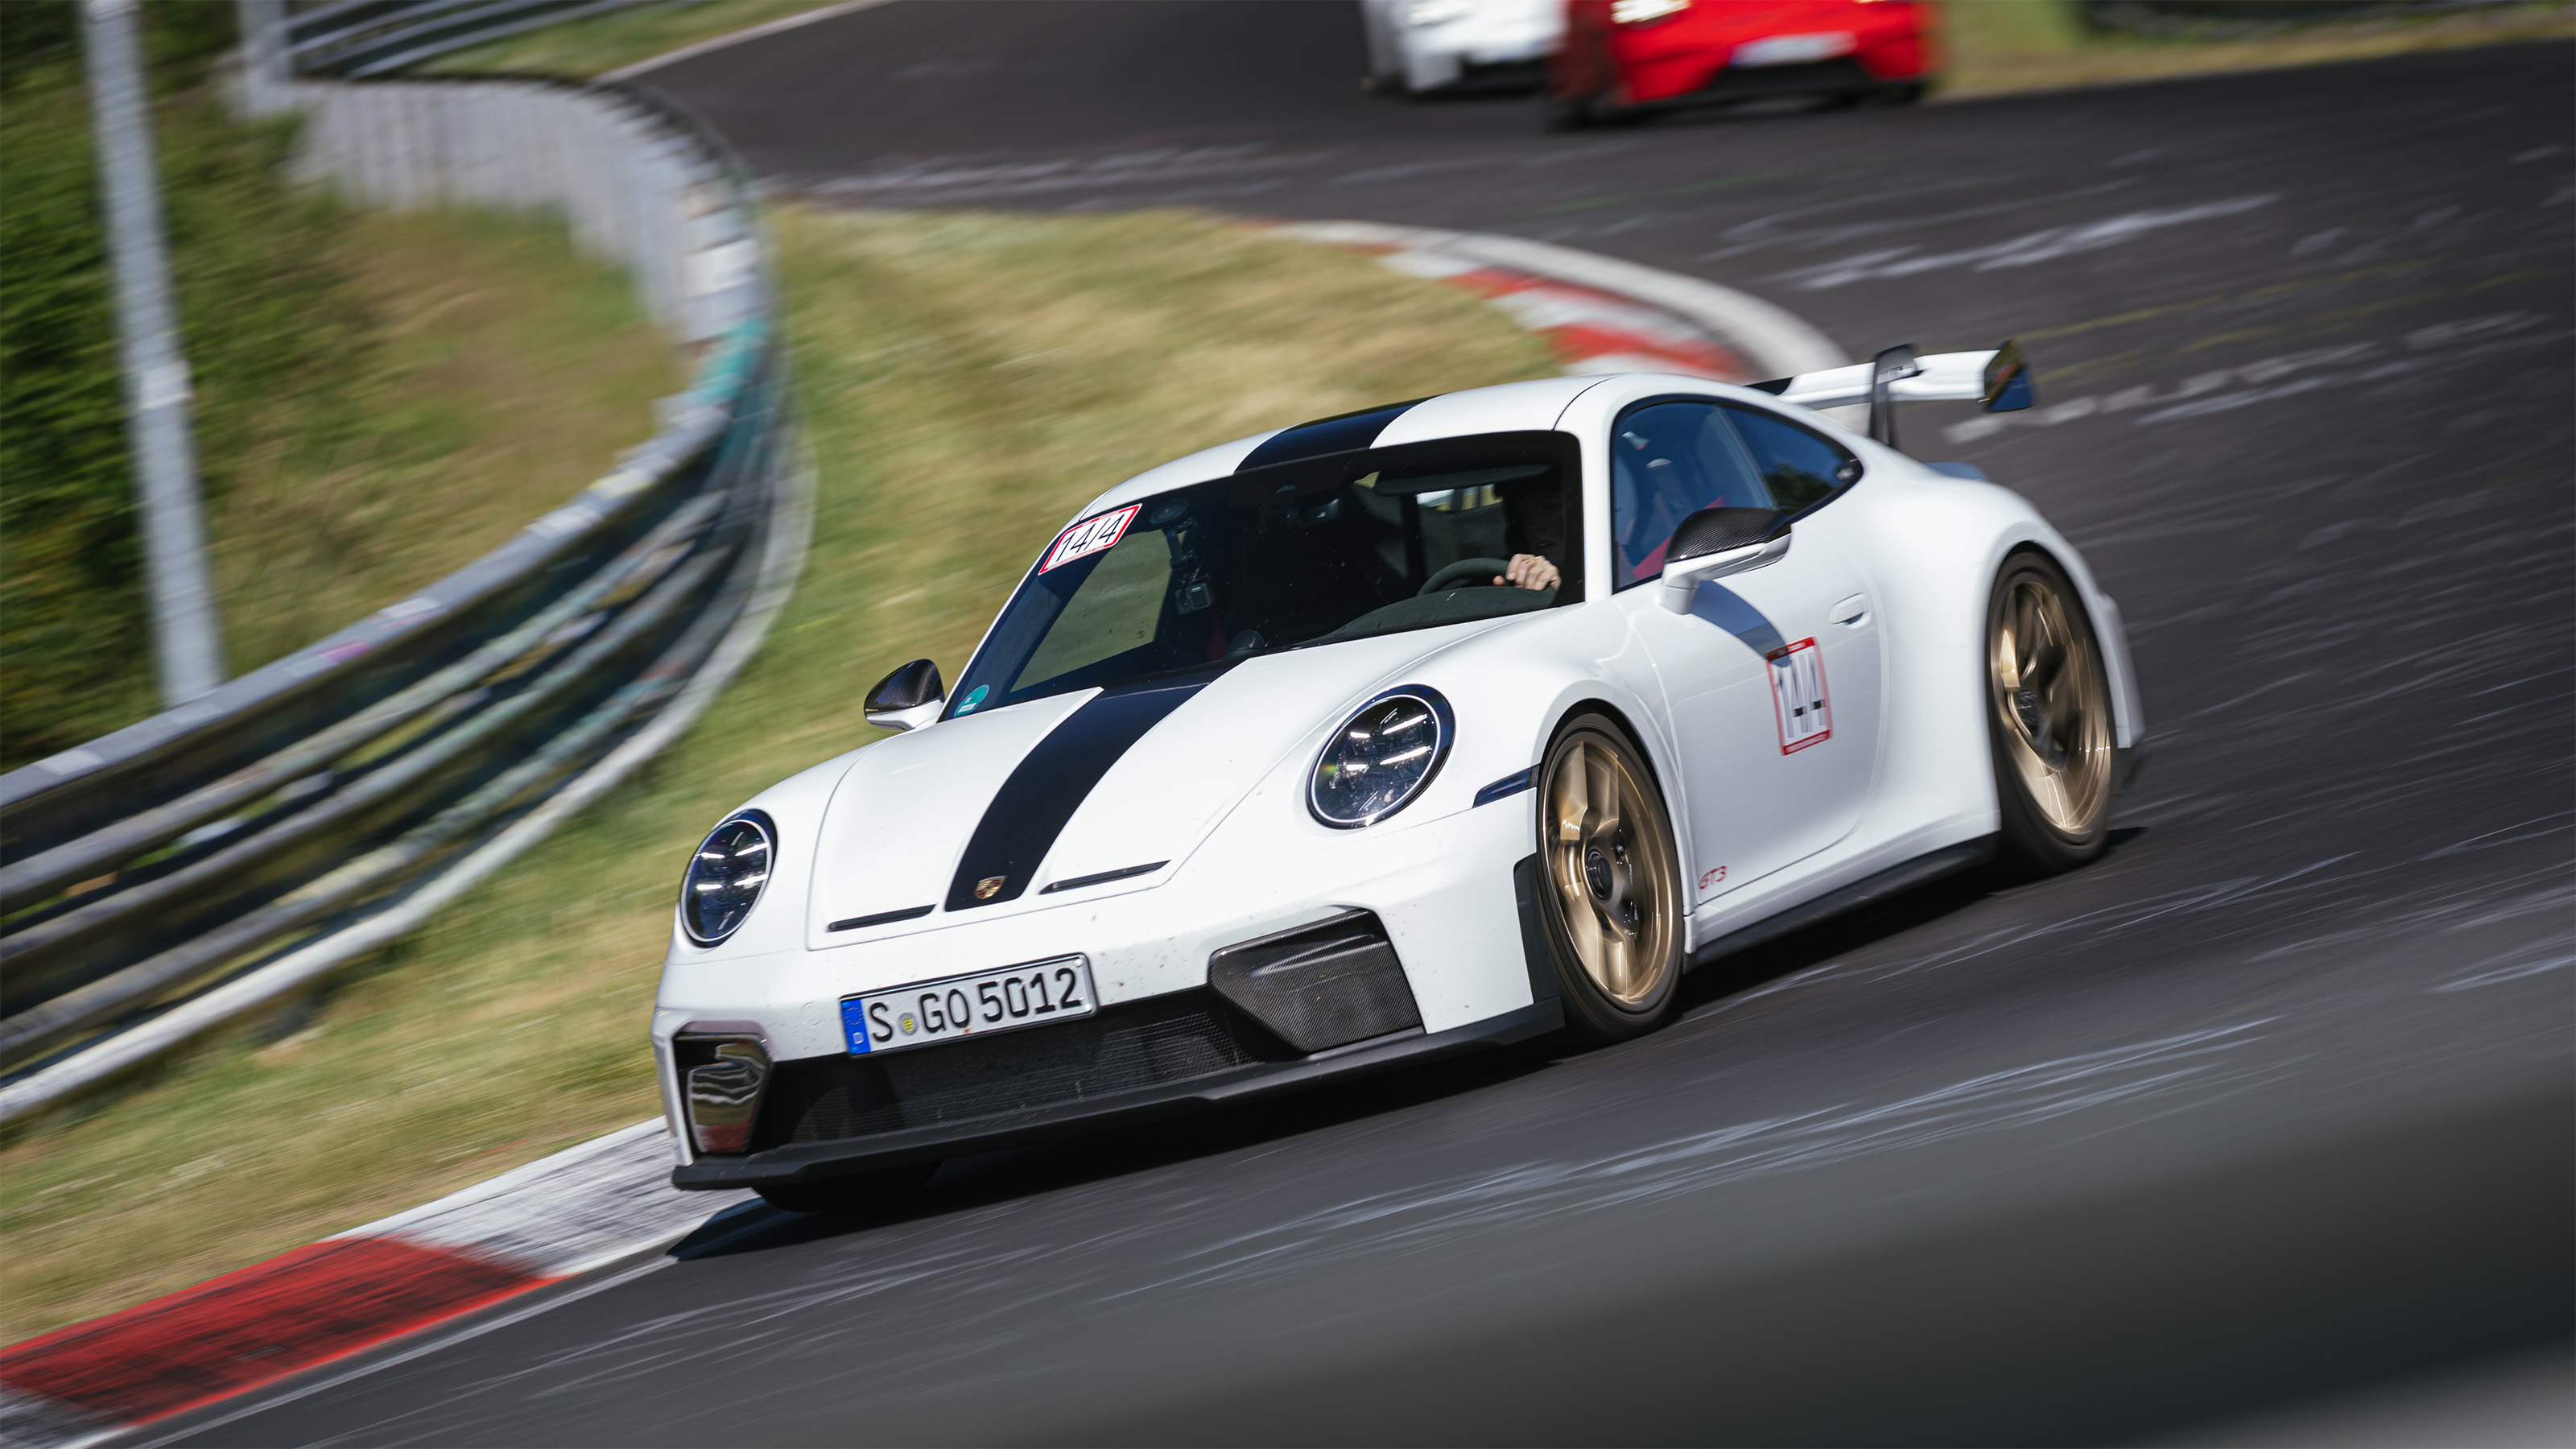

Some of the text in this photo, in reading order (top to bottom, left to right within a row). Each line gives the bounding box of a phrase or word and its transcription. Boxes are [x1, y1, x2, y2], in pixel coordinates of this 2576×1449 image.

[1055, 513, 1125, 563] 14/4
[1699, 865, 1728, 890] GT3
[869, 968, 1082, 1042] S GO 5012
